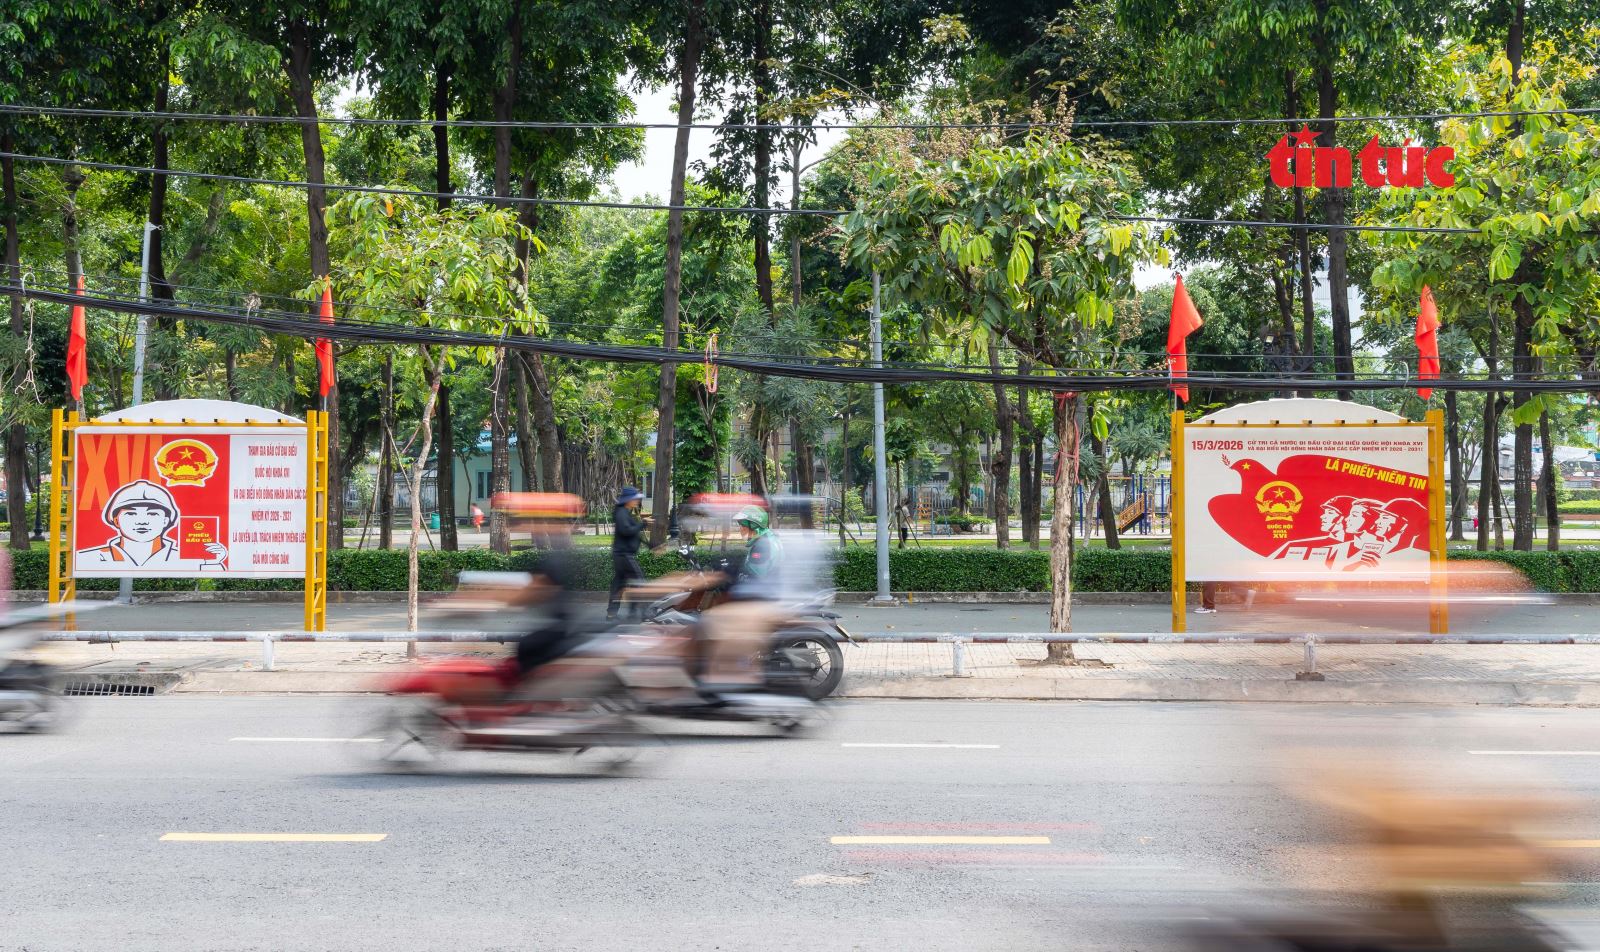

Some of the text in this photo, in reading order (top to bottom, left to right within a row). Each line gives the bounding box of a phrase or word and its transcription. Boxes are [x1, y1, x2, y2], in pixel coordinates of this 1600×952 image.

[1192, 440, 1244, 450] 15/3/2026
[79, 434, 163, 510] XVI
[1325, 458, 1339, 471] LÁ
[1408, 476, 1427, 490] TIN
